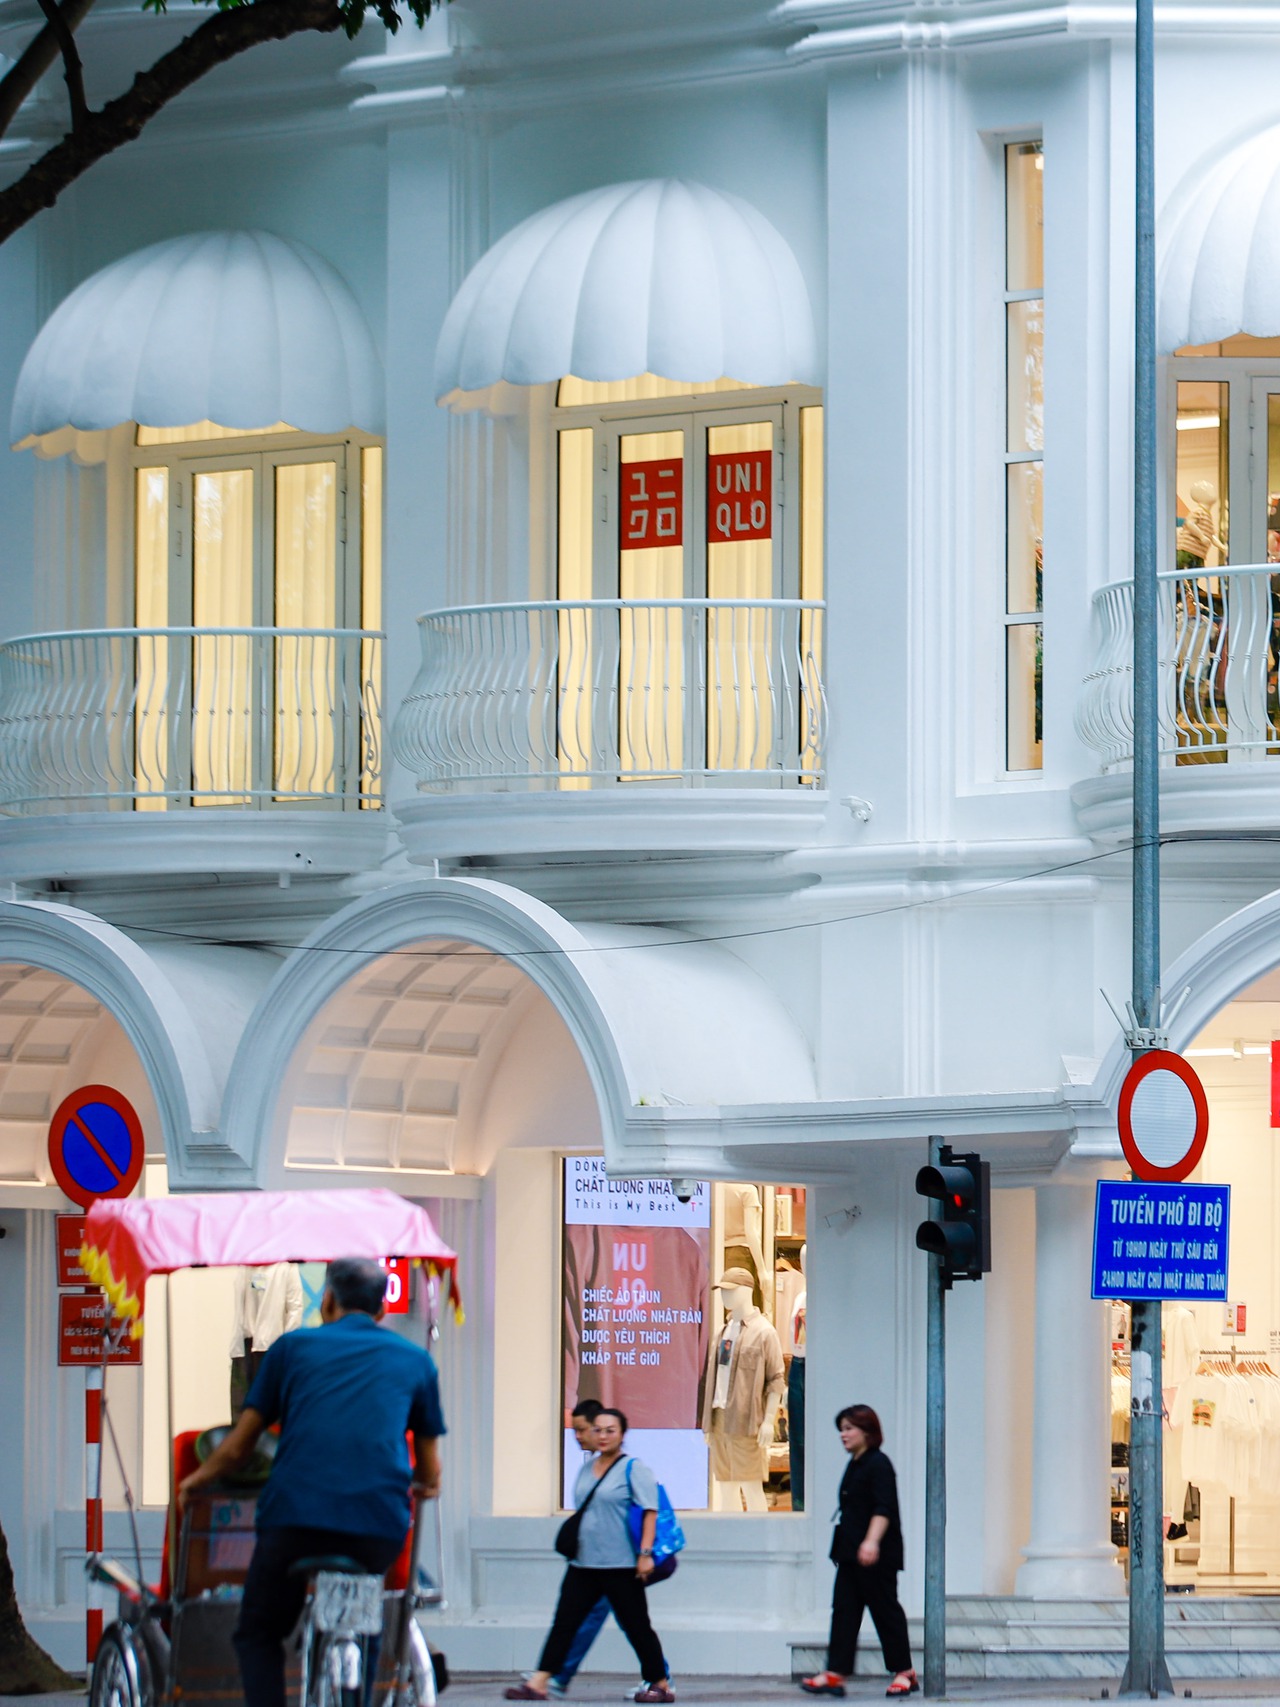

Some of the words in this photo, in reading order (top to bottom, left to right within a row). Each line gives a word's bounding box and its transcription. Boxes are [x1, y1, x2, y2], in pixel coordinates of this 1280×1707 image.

[716, 462, 761, 494] UNI
[716, 500, 766, 538] QLO
[575, 1175, 605, 1193] CHẤT
[575, 1199, 601, 1209] This
[609, 1200, 618, 1210] is
[627, 1200, 641, 1212] My
[650, 1201, 675, 1212] Best
[1111, 1193, 1154, 1224] TUYẾN
[1158, 1194, 1186, 1226] PHỐ
[1188, 1202, 1201, 1226] ĐI
[1204, 1197, 1222, 1232] BỘ
[1149, 1238, 1168, 1258] NGÀY
[1186, 1239, 1201, 1260] SÁU
[1203, 1239, 1218, 1260] ĐẾN
[1126, 1268, 1146, 1288] NGÀY
[1148, 1266, 1162, 1289] CHỦ
[1164, 1269, 1183, 1293] NHẬT
[1185, 1269, 1204, 1290] HÀNG
[582, 1285, 613, 1302] CHIẾC
[632, 1290, 660, 1304] THUN
[582, 1304, 610, 1322] CHẤT
[651, 1307, 679, 1326] NHẬT
[615, 1328, 634, 1344] YÊU
[639, 1328, 670, 1344] THÍCH
[582, 1347, 611, 1364] KHẮP
[615, 1348, 636, 1365] THẾ
